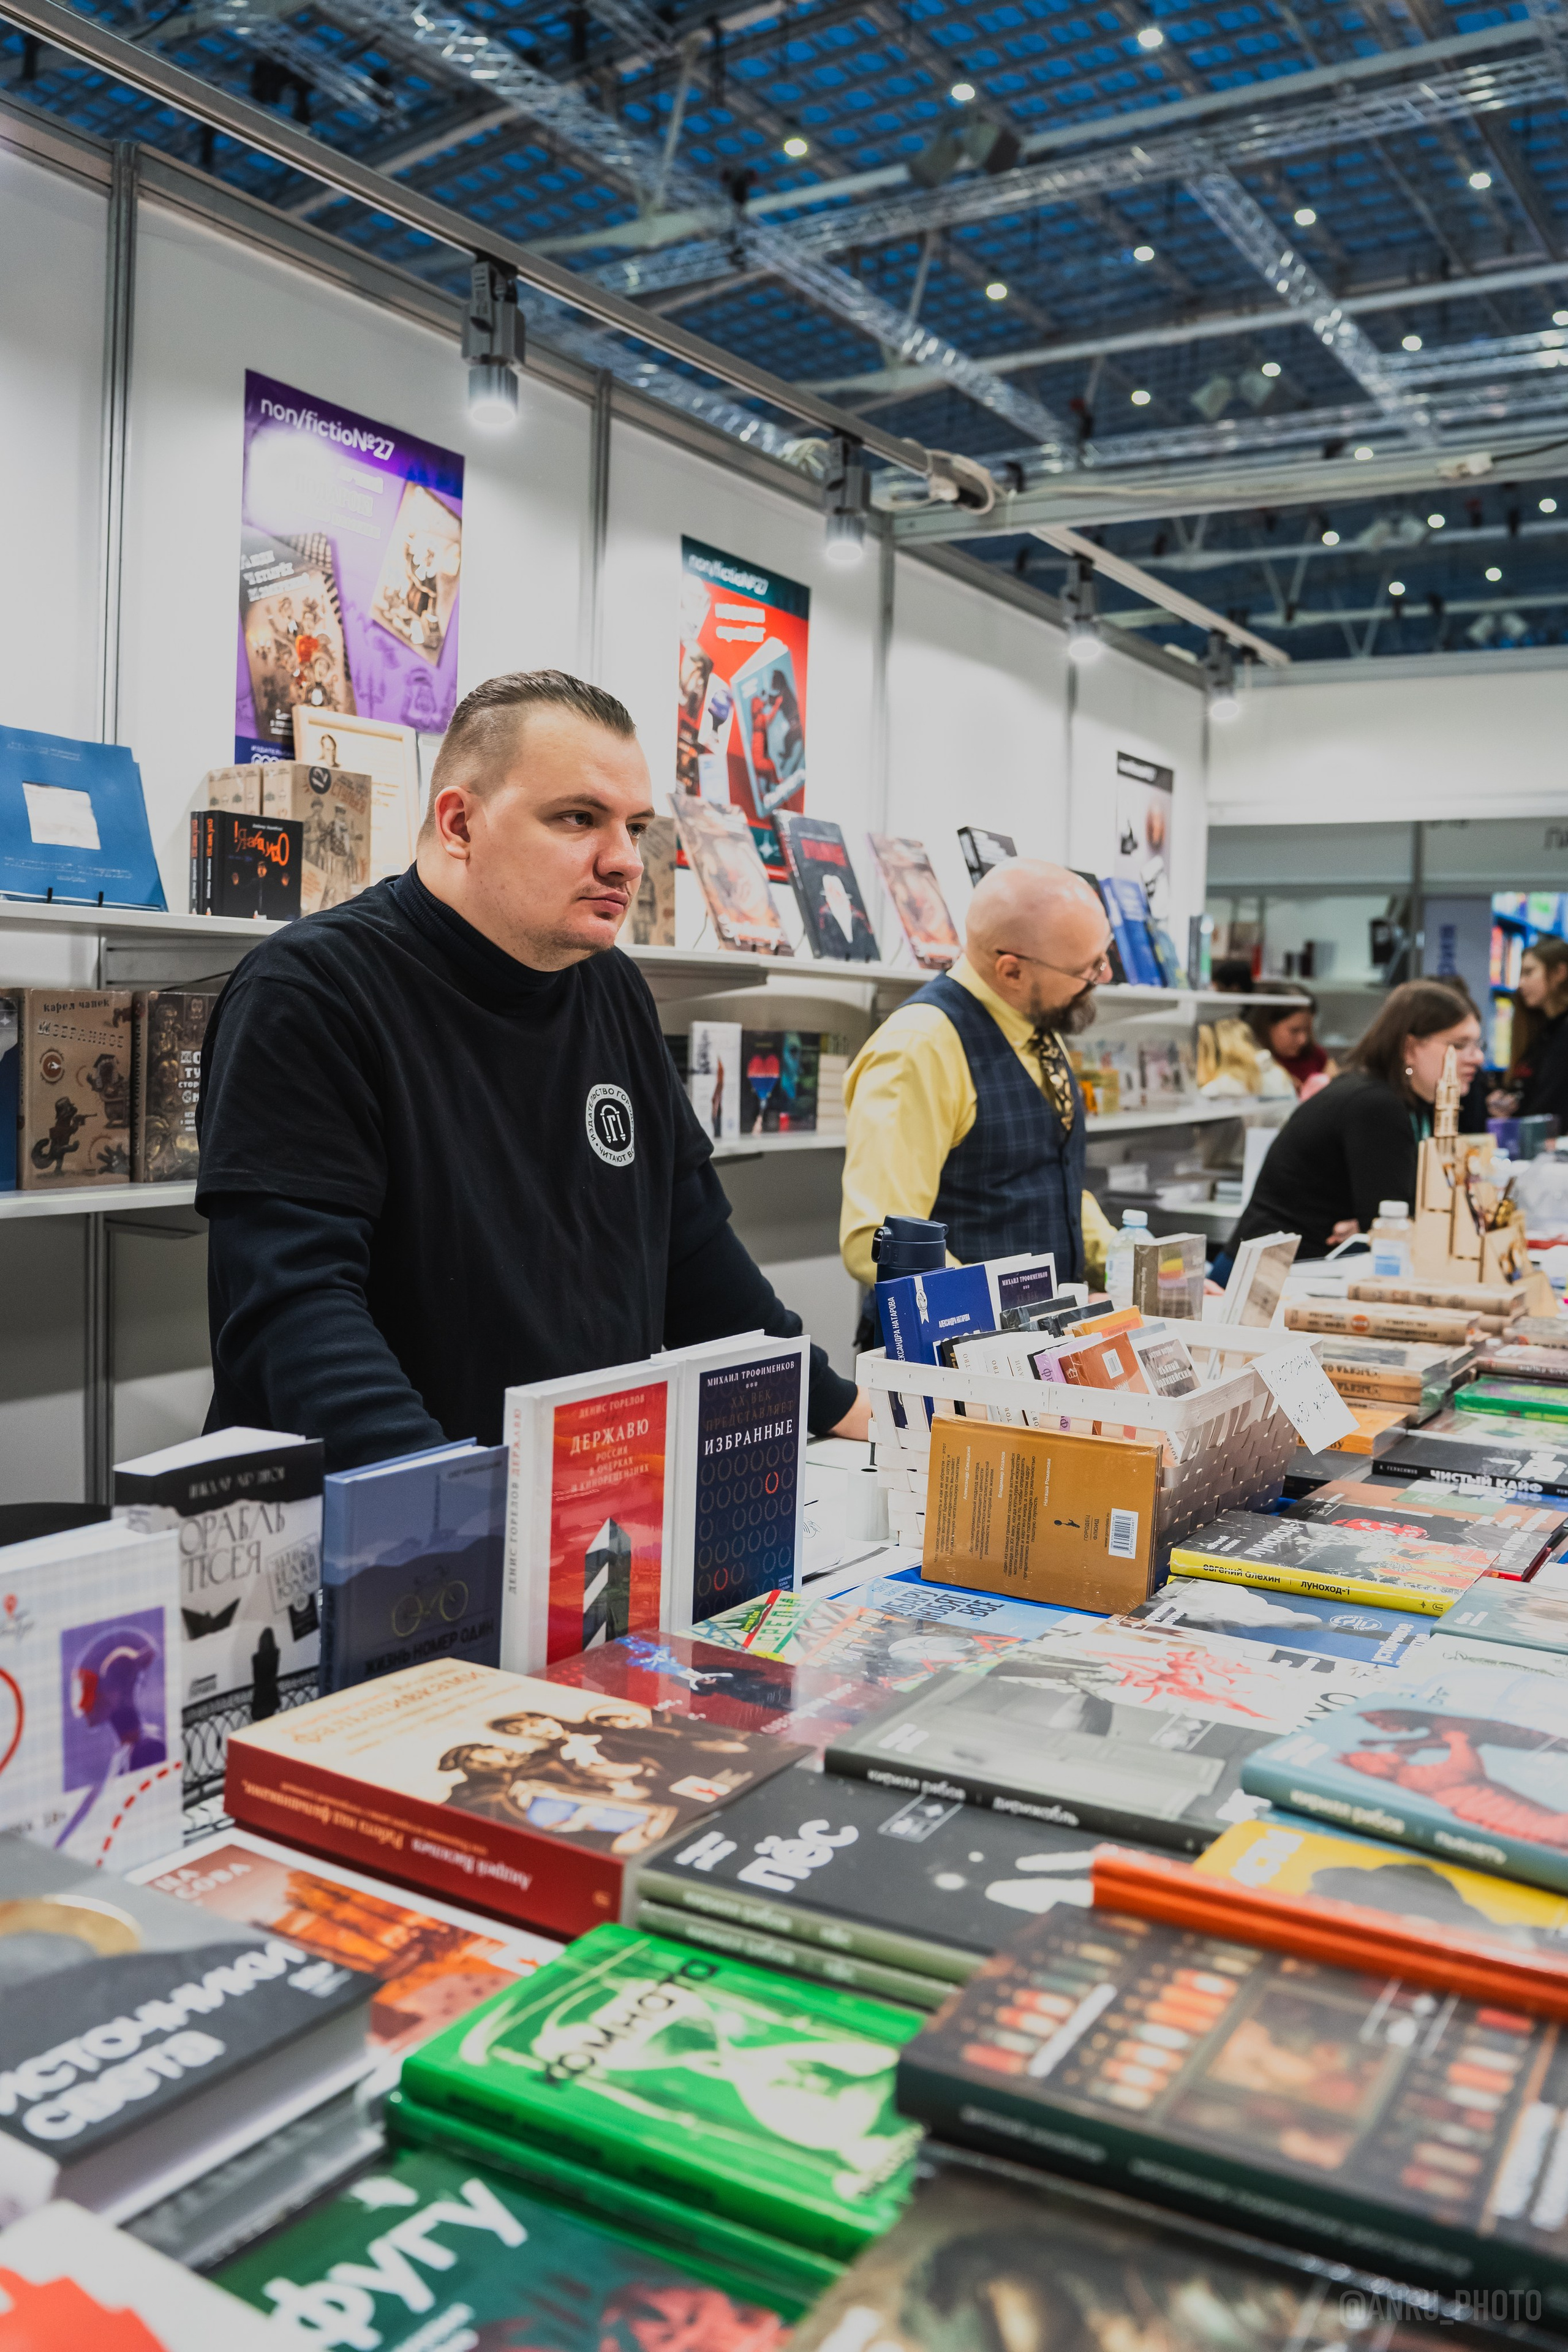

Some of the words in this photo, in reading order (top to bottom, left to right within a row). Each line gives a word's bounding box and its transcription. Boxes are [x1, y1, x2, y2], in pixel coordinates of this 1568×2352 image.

[588, 1088, 614, 1141] ИЗДАТЕЛЬСТВО
[599, 1146, 626, 1163] ЧИТАЮТ
[888, 1297, 899, 1329] НАТАРОВА
[939, 1319, 956, 1328] АЛЕКСАНДРА
[956, 1314, 971, 1324] НАТАРОВА
[894, 1330, 906, 1362] ЕКСАНДРА
[707, 1373, 739, 1387] МИХАИЛ
[742, 1361, 794, 1379] ТРОФИМЕНКОВ
[1156, 1368, 1192, 1389] ПОЛИЦЕЙСКИЙ
[1158, 1360, 1180, 1375] ПЬЯНЫЙ
[609, 1394, 645, 1411] ГОРЕЛОВ
[752, 1389, 772, 1404] ВЕК
[705, 1400, 794, 1431] ПРЕДСТАВЛЯЕТ
[570, 1419, 649, 1456] ДЕРЖАВЮ
[704, 1419, 793, 1455] ИЗБРАННЫЕ
[596, 1446, 628, 1462] РОССИЯ
[597, 1456, 633, 1474] ОЧЕРКАХ
[581, 1463, 649, 1491] КИНОРЕЦЕНЗИЯХ
[1430, 1469, 1491, 1487] ЧИСТЫЙ
[1495, 1478, 1543, 1493] КАЙФ
[510, 1482, 519, 1543] ГОРЕЛОВ
[179, 1503, 285, 1556] ОРАБЛЬ
[1203, 1564, 1243, 1577] евгений
[1245, 1570, 1281, 1583] алехин
[876, 1588, 938, 1615] ИБАРУ
[956, 1600, 1005, 1618] ВСЕ
[413, 1630, 458, 1659] НОМЕР
[461, 1619, 494, 1644] ОДИН
[921, 1776, 966, 1800] рябов
[993, 1796, 1079, 1827] дирижабль
